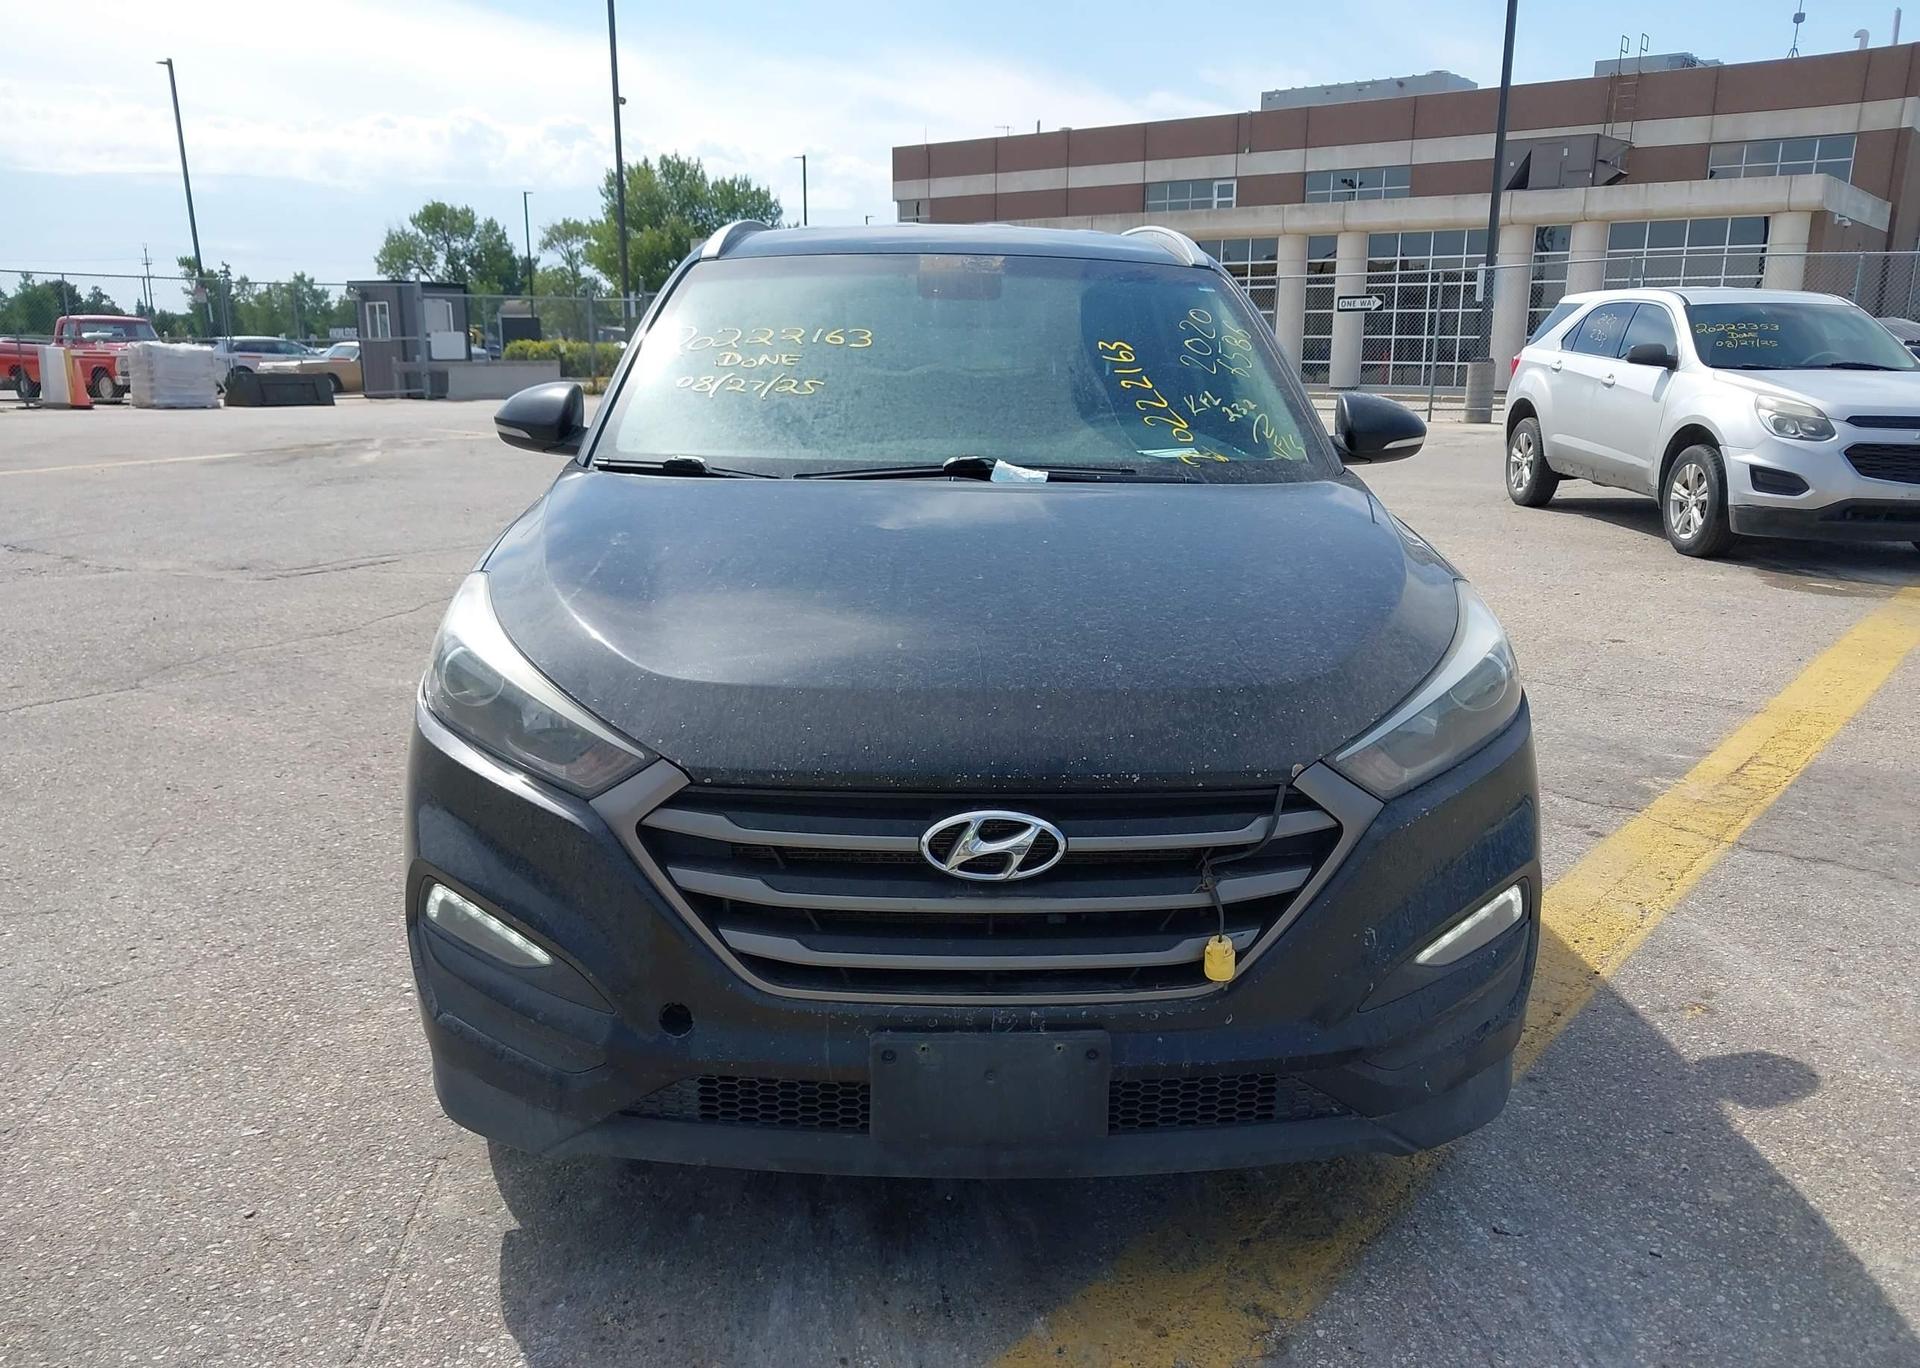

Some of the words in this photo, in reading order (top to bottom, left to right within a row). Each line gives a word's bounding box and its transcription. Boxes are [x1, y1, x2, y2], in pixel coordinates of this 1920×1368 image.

[1340, 300, 1357, 308] ONE
[1360, 299, 1377, 307] WAY
[1695, 322, 1780, 334] 20222353
[676, 373, 825, 399] 08/27/25
